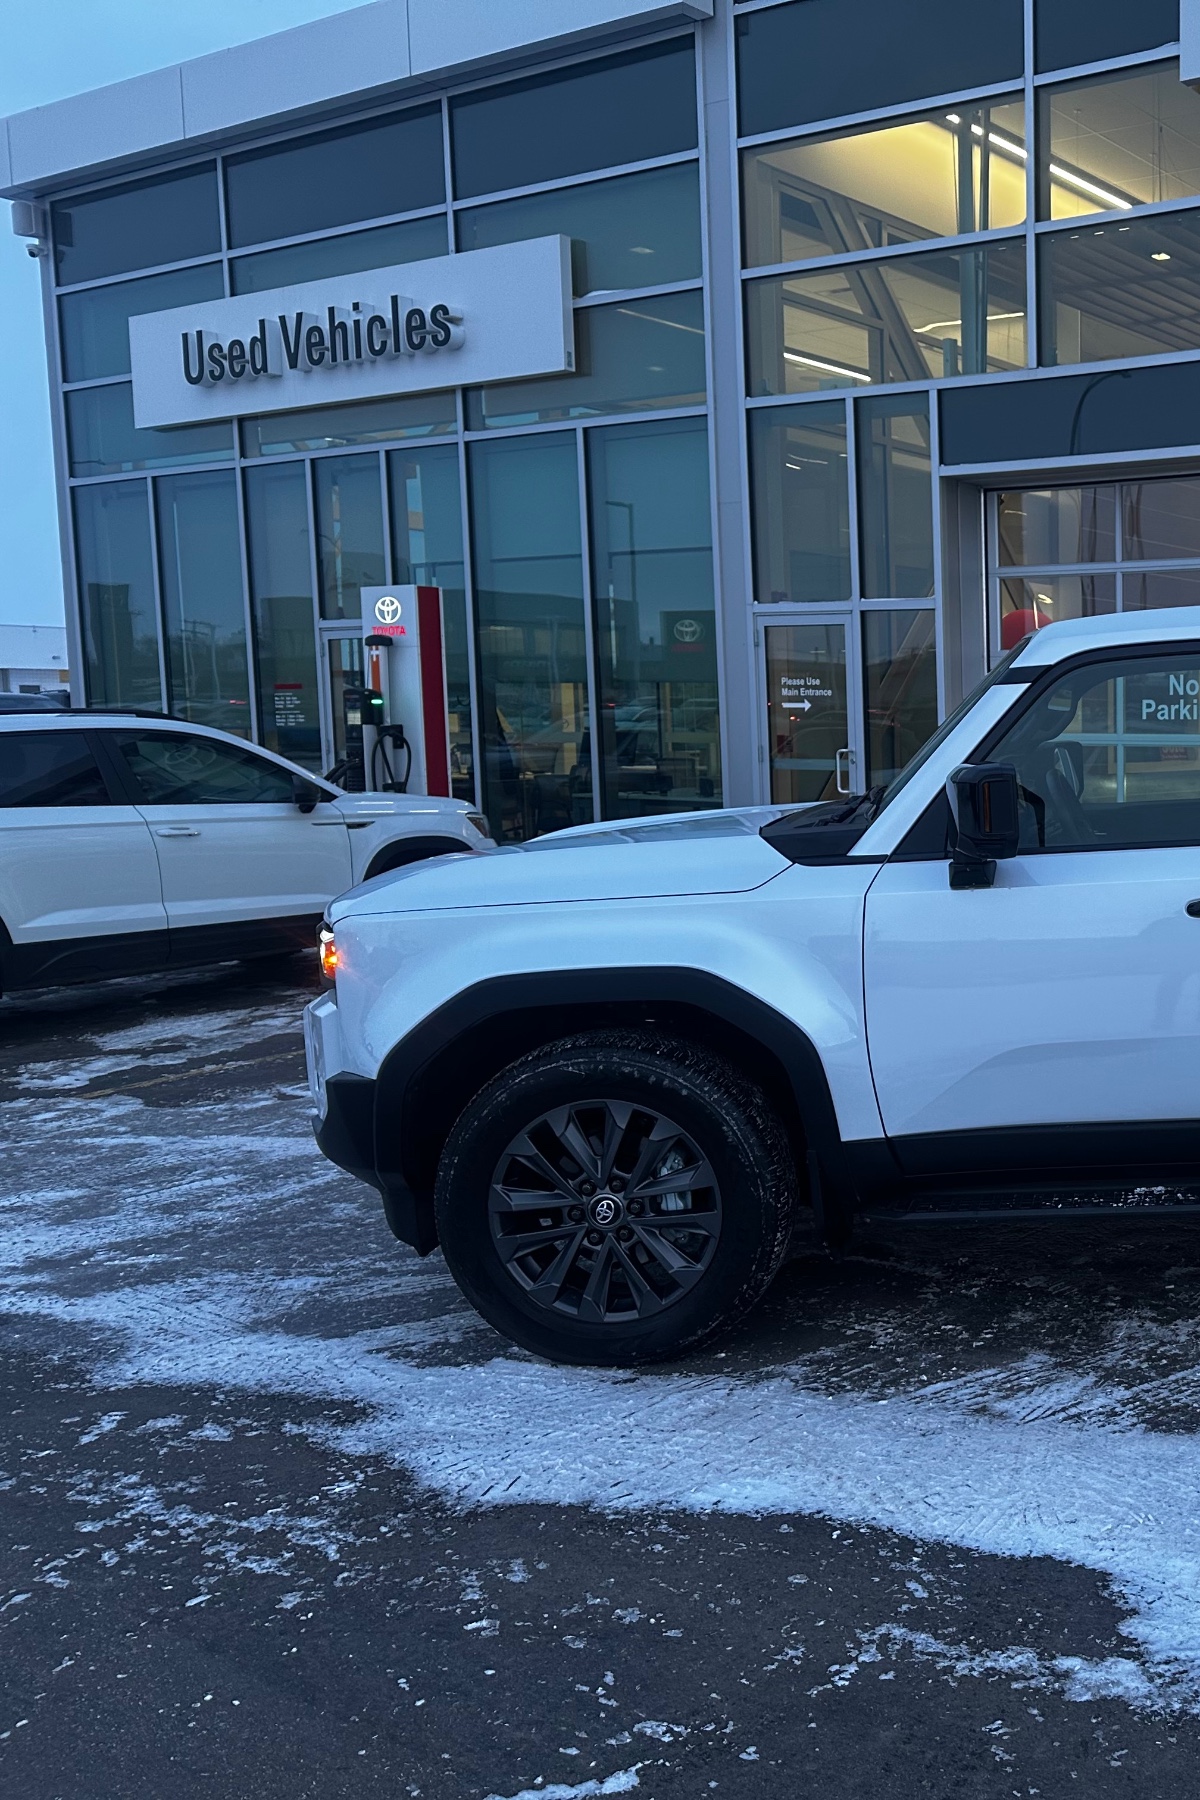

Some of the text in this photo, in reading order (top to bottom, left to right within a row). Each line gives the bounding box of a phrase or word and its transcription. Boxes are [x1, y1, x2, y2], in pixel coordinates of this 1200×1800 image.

[181, 294, 452, 385] Used Vehicles
[371, 625, 407, 636] TOYOTA
[781, 676, 821, 686] Please Use
[1168, 674, 1200, 696] No
[781, 687, 833, 697] Main Entrance
